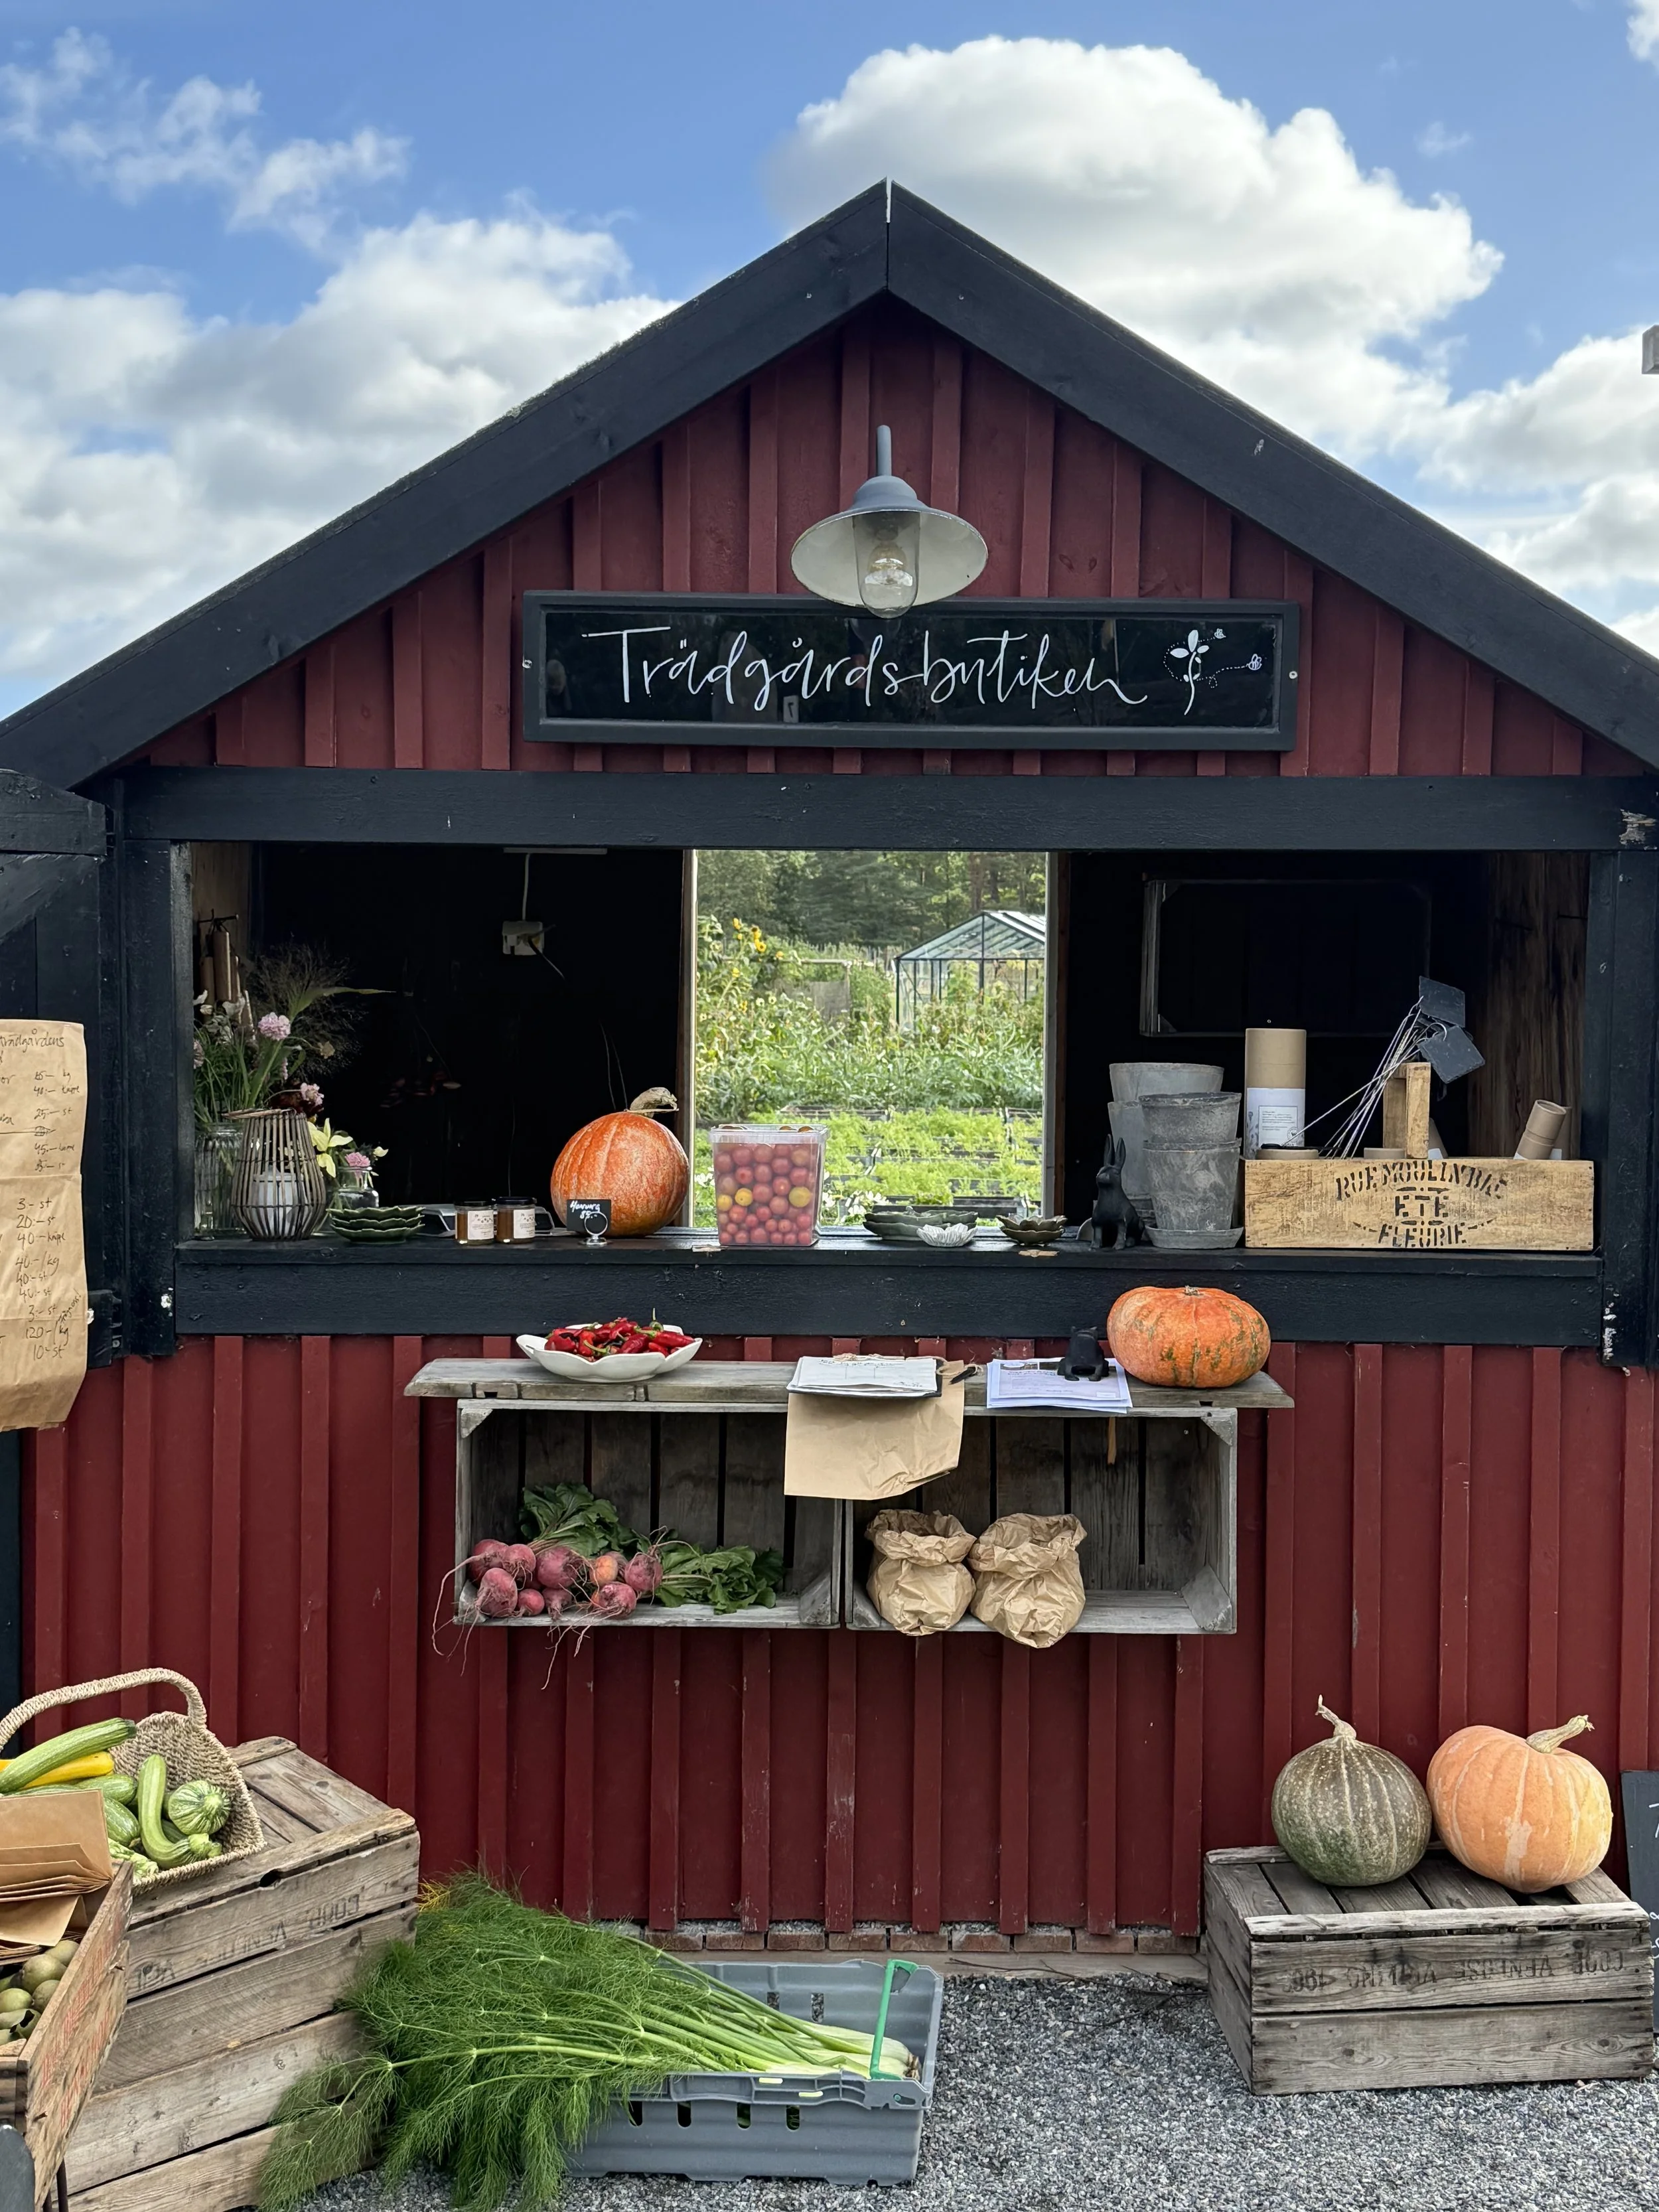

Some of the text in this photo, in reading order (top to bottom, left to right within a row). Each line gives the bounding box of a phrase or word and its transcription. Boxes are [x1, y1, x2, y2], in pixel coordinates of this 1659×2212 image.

[581, 627, 1147, 711] Trädgårdsbutiken
[1336, 1166, 1377, 1201] RUE
[39, 1197, 52, 1209] st
[1395, 1195, 1449, 1217] ETE
[1378, 1223, 1467, 1248] FLEURIE
